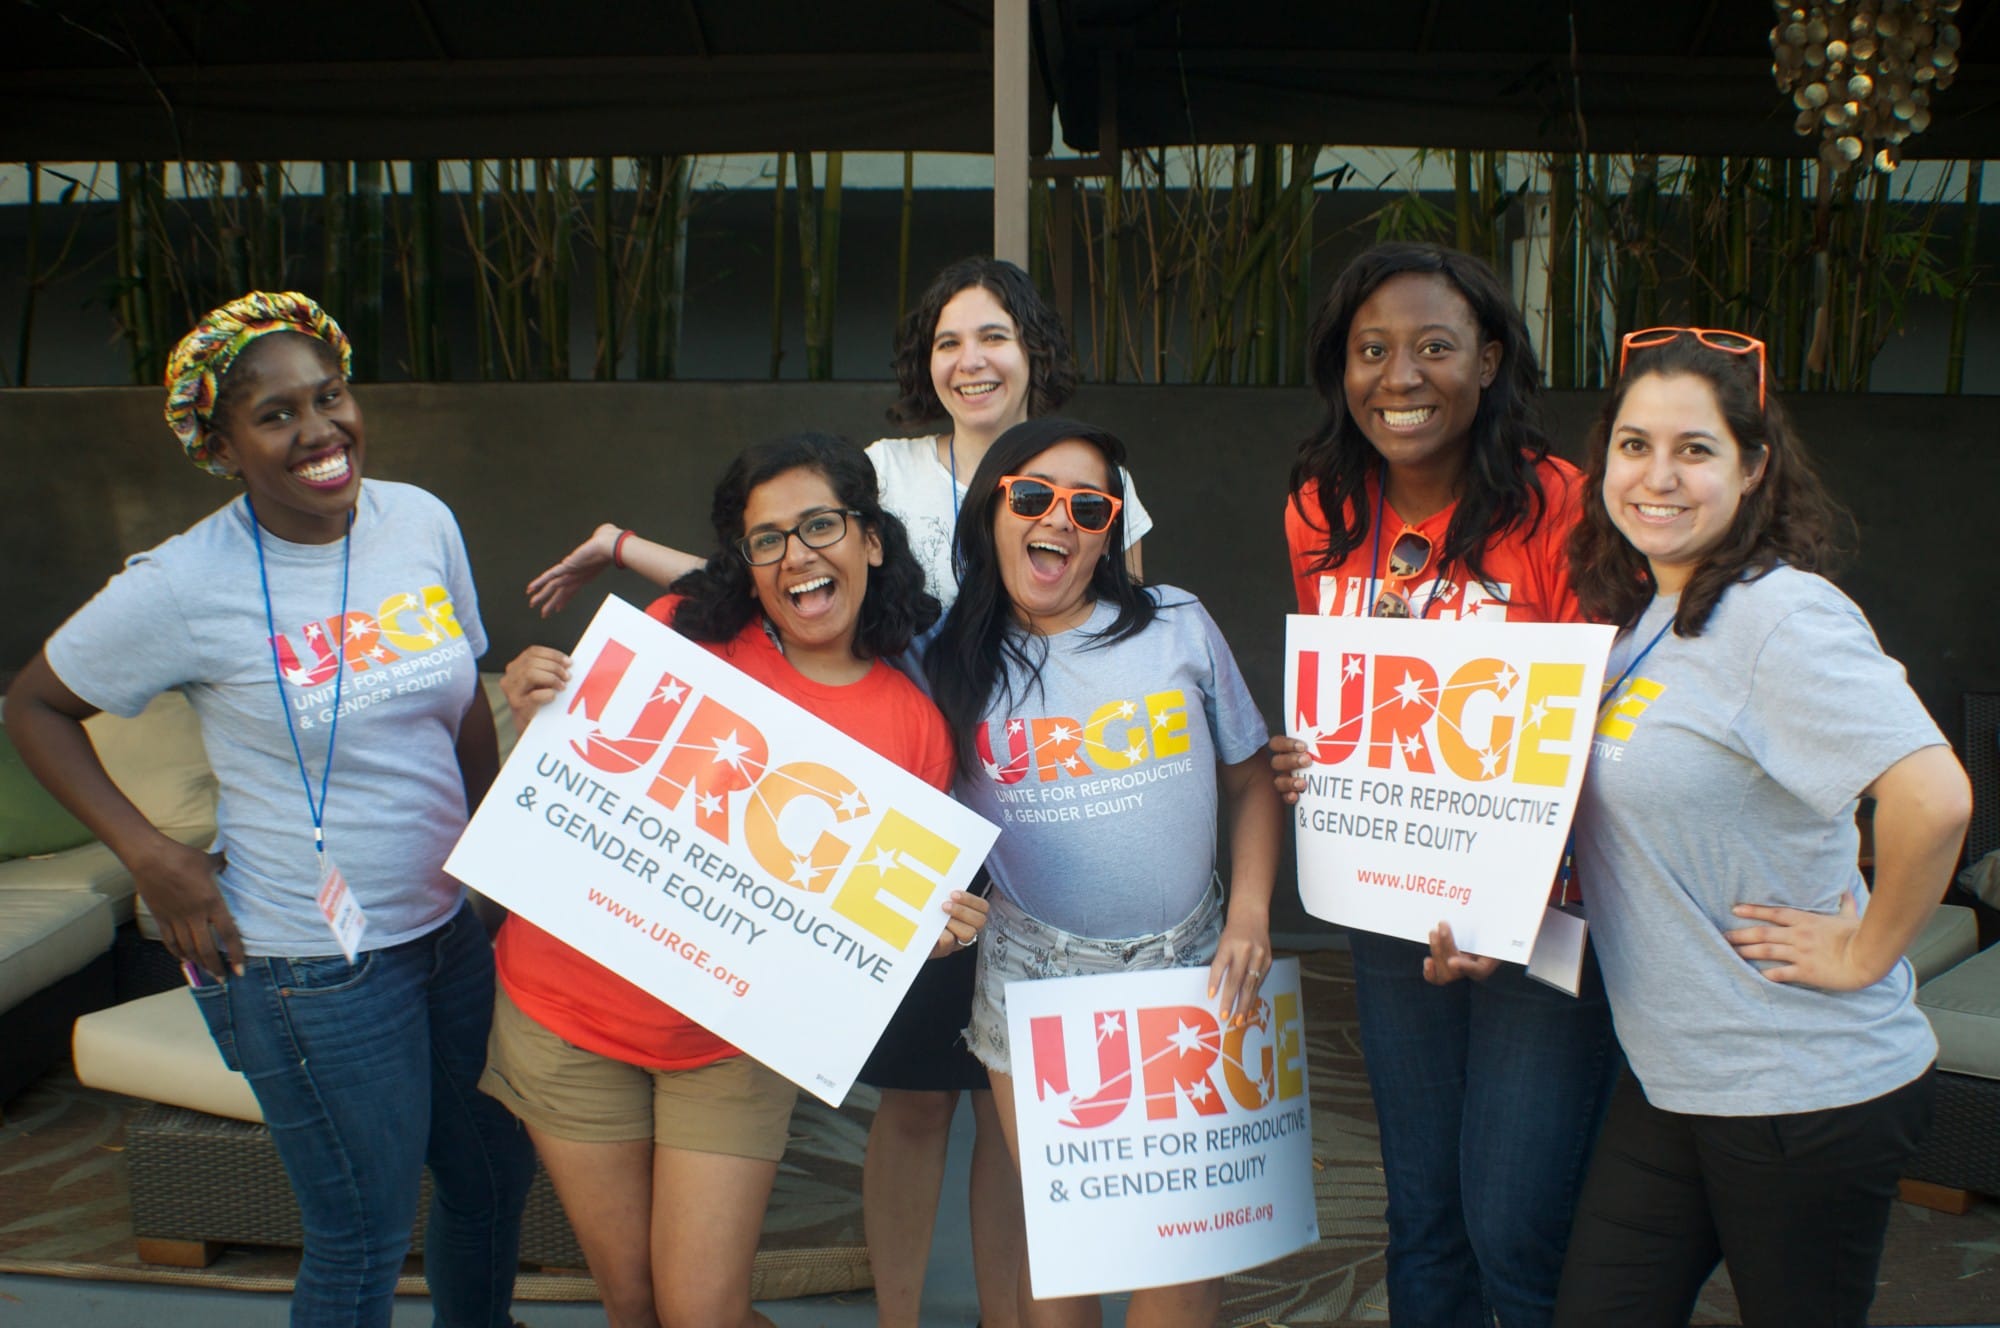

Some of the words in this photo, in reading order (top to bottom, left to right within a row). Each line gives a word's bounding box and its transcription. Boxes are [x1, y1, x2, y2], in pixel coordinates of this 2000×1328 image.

[267, 585, 463, 687] URGE
[293, 681, 350, 710] UNITE
[353, 671, 389, 690] FOR
[300, 715, 315, 730] &
[319, 688, 392, 722] GENDER
[396, 666, 453, 695] EQUITY
[1295, 650, 1586, 788] URGE
[975, 689, 1191, 785] URGE
[567, 637, 960, 952] URGE
[995, 788, 1037, 803] UNITE
[1041, 785, 1076, 802] FOR
[1080, 758, 1193, 798] REPRODUCTIVE
[1004, 808, 1013, 822] &
[1015, 806, 1081, 823] GENDER
[1084, 793, 1144, 818] EQUITY
[1360, 780, 1404, 807] FOR
[1410, 786, 1560, 826] REPRODUCTIVE
[1300, 806, 1308, 828] &
[1312, 809, 1398, 842] GENDER
[1404, 822, 1478, 854] EQUITY
[516, 785, 537, 811] &
[545, 803, 660, 883] GENDER
[662, 873, 767, 945] EQUITY
[536, 752, 621, 816] UNITE
[621, 805, 681, 853] FOR
[683, 843, 893, 983] REPRODUCTIVE
[1357, 869, 1472, 905] www.URGE.org
[588, 887, 750, 998] www.URGE.org
[1029, 992, 1304, 1129] URGE
[1046, 1137, 1133, 1166] UNITE
[1143, 1132, 1198, 1158] FOR
[1206, 1107, 1306, 1151] REPRODUCTIVE
[1049, 1179, 1070, 1202] &
[1080, 1167, 1198, 1199] GENDER
[1206, 1154, 1267, 1187] EQUITY
[1157, 1203, 1274, 1237] www.URGE.org
